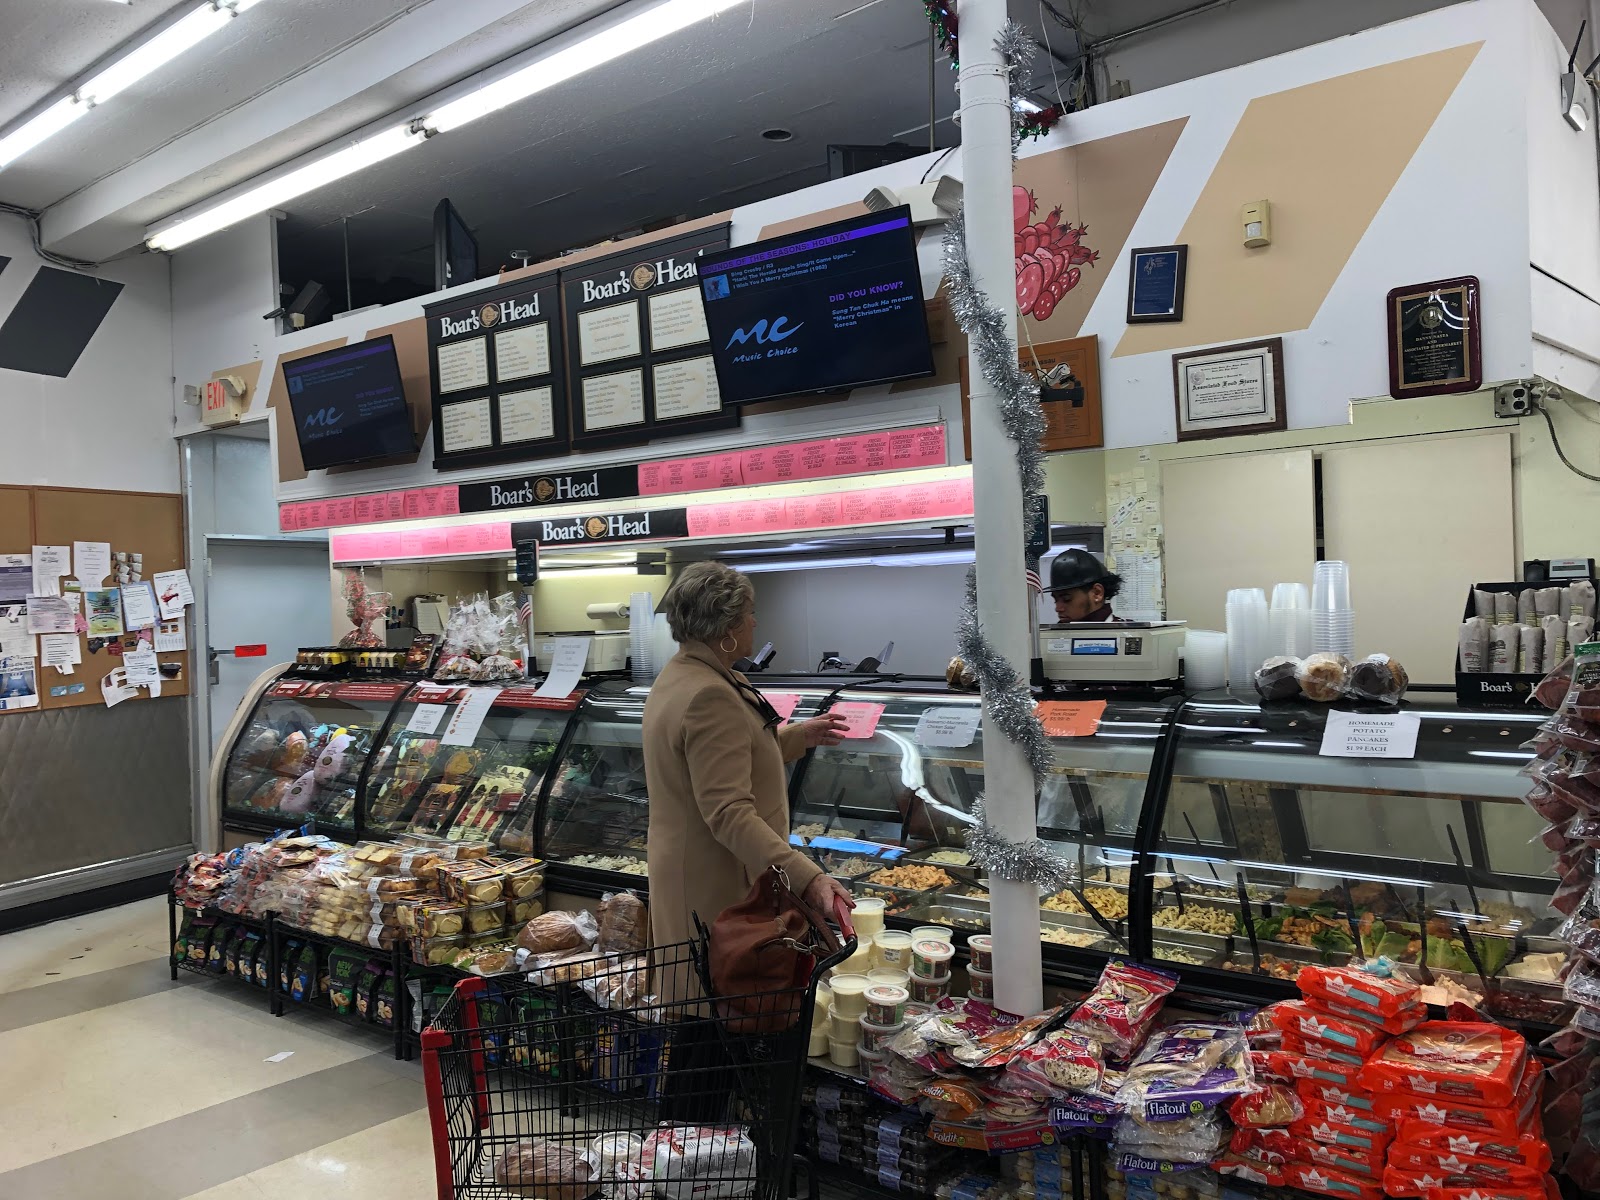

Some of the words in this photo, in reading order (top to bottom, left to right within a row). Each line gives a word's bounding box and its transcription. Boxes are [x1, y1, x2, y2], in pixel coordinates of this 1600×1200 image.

[736, 257, 747, 267] OF
[750, 252, 766, 264] THE
[767, 243, 807, 260] SEASONS:
[812, 232, 851, 248] HOLIDAY
[782, 270, 810, 279] Christmas
[582, 270, 631, 304] Boar's
[829, 293, 845, 303] DID
[847, 288, 867, 299] YOU
[869, 281, 904, 295] KNOW?
[440, 309, 480, 338] Boar's
[499, 293, 541, 324] Head
[834, 320, 858, 328] Korean
[1430, 341, 1462, 349] SUPERMARKET
[732, 352, 762, 364] Music
[767, 346, 798, 358] Choice
[1031, 358, 1056, 368] Nssau
[490, 479, 533, 507] Boar's
[556, 473, 600, 499] Head
[542, 516, 585, 542] Boar's
[608, 512, 651, 538] Head
[1480, 682, 1512, 692] Boar's
[1150, 1102, 1187, 1116] Flatout
[1191, 1102, 1202, 1110] 90
[1392, 1108, 1401, 1116] 24
[933, 1132, 958, 1143] Foldit
[1124, 1154, 1157, 1171] Flatout
[1162, 1163, 1172, 1172] 90
